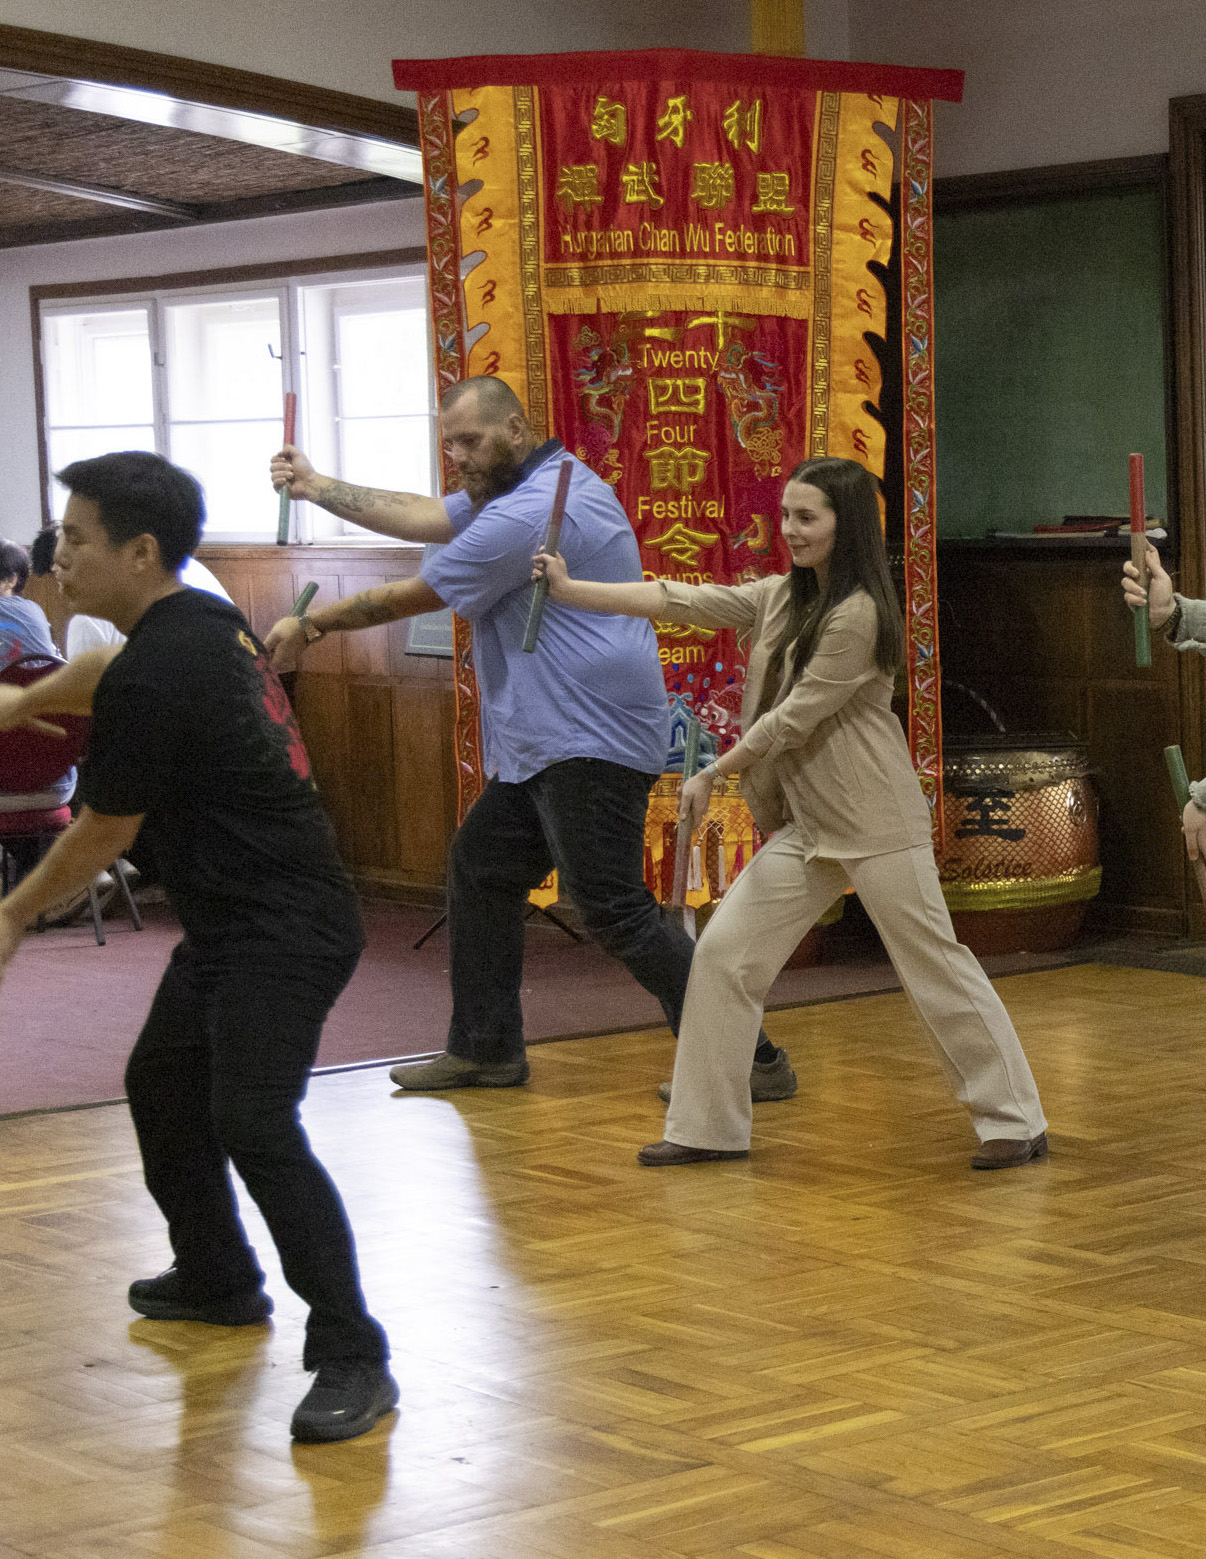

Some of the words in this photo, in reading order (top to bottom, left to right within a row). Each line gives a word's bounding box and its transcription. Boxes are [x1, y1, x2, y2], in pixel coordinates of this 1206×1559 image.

[591, 96, 762, 153] 匈牙利
[556, 162, 796, 218] 禪武聯盟
[559, 224, 634, 259] Hungarian
[639, 221, 680, 252] Chan
[683, 222, 710, 253] Wu
[714, 222, 795, 256] Federation
[640, 343, 719, 374] Twenty
[649, 378, 707, 415] 四
[646, 420, 698, 444] Four
[637, 495, 725, 520] Festival
[657, 644, 705, 665] eam
[939, 857, 1033, 881] Solstice
